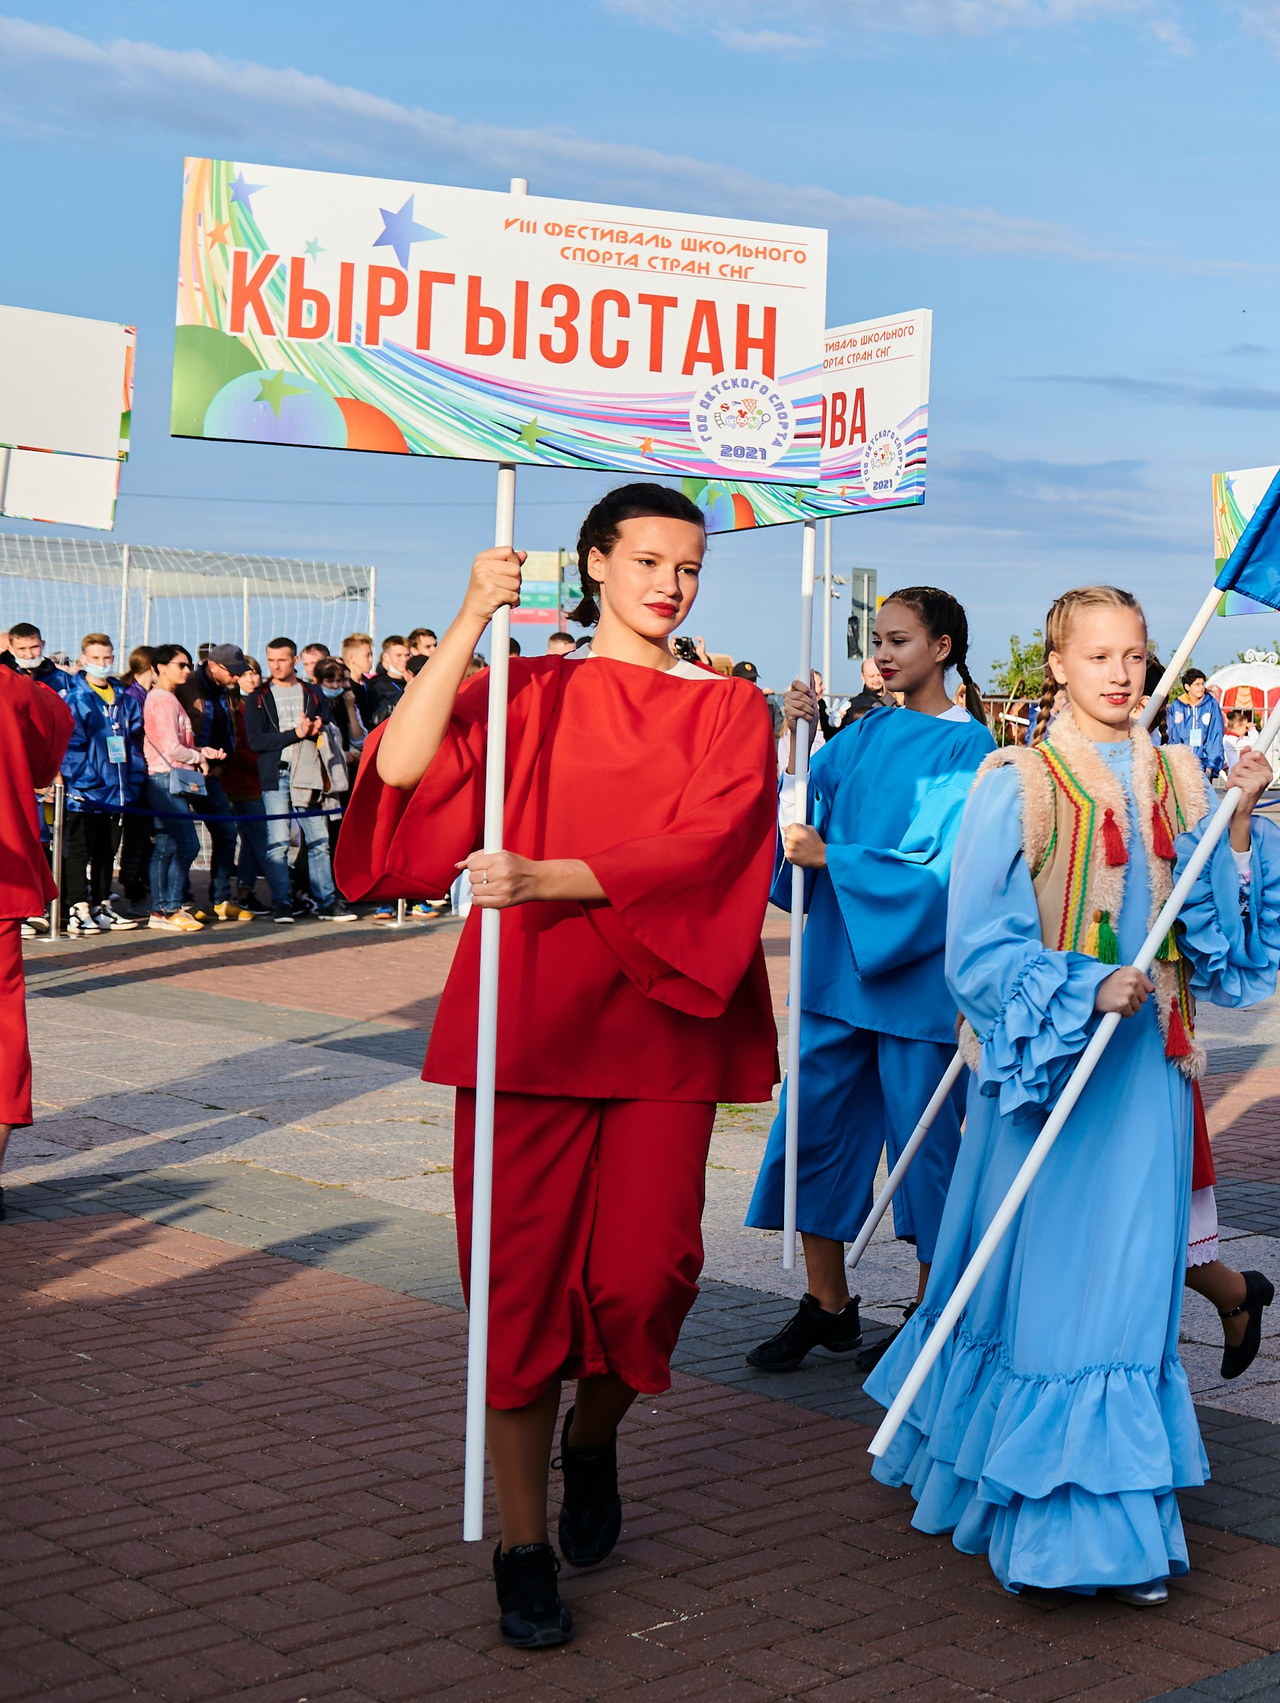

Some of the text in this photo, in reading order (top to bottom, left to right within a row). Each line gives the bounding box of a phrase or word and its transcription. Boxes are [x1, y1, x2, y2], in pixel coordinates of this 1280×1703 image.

[543, 222, 672, 249] ФЕСТИВАЛЬ
[680, 238, 807, 264] ШКОЛЬНОГО
[560, 246, 756, 280] СПОРТА СТРАН СНГ
[229, 250, 778, 380] КЫРГЫЗСТАН
[860, 325, 915, 346] ШКОЛЬНОГО
[847, 350, 873, 364] СТРАН
[875, 346, 892, 358] СНГ
[696, 378, 789, 448] ГОД ДЕТСКОГО СПОРТА
[720, 444, 767, 460] 2021
[873, 479, 893, 491] 2021
